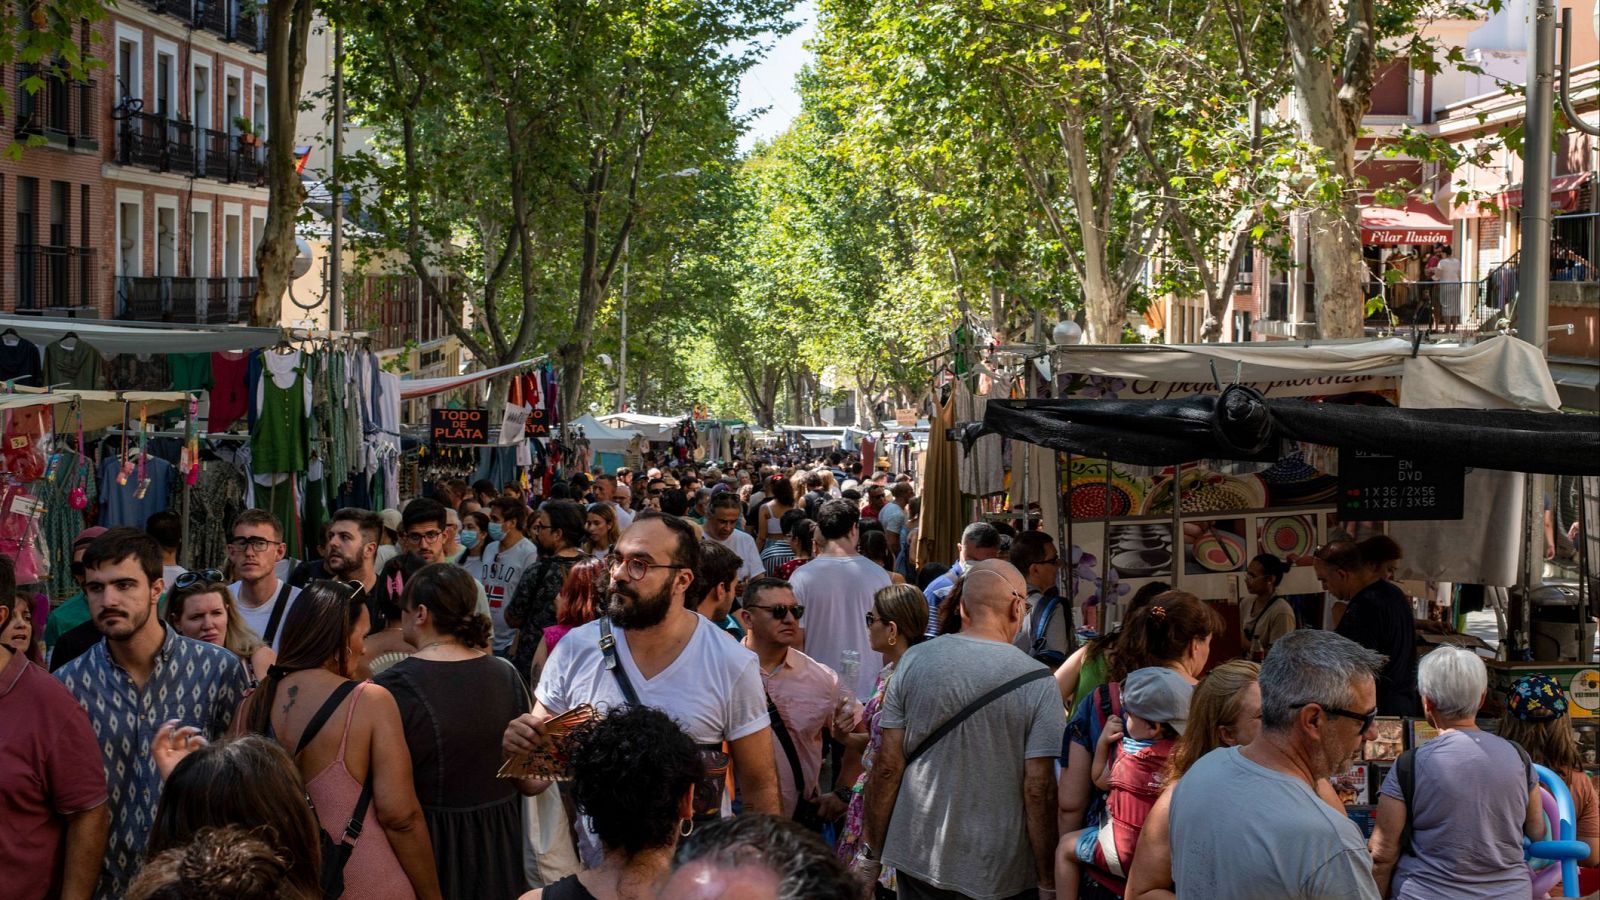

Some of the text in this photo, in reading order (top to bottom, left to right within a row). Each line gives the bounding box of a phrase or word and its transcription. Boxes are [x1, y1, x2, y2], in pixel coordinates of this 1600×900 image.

[1370, 230, 1448, 243] Pilar Ilusión
[440, 410, 481, 421] TODO
[435, 428, 483, 439] PLATA
[1398, 460, 1413, 470] EN
[1398, 471, 1423, 481] DVD
[482, 563, 515, 582] OSLO
